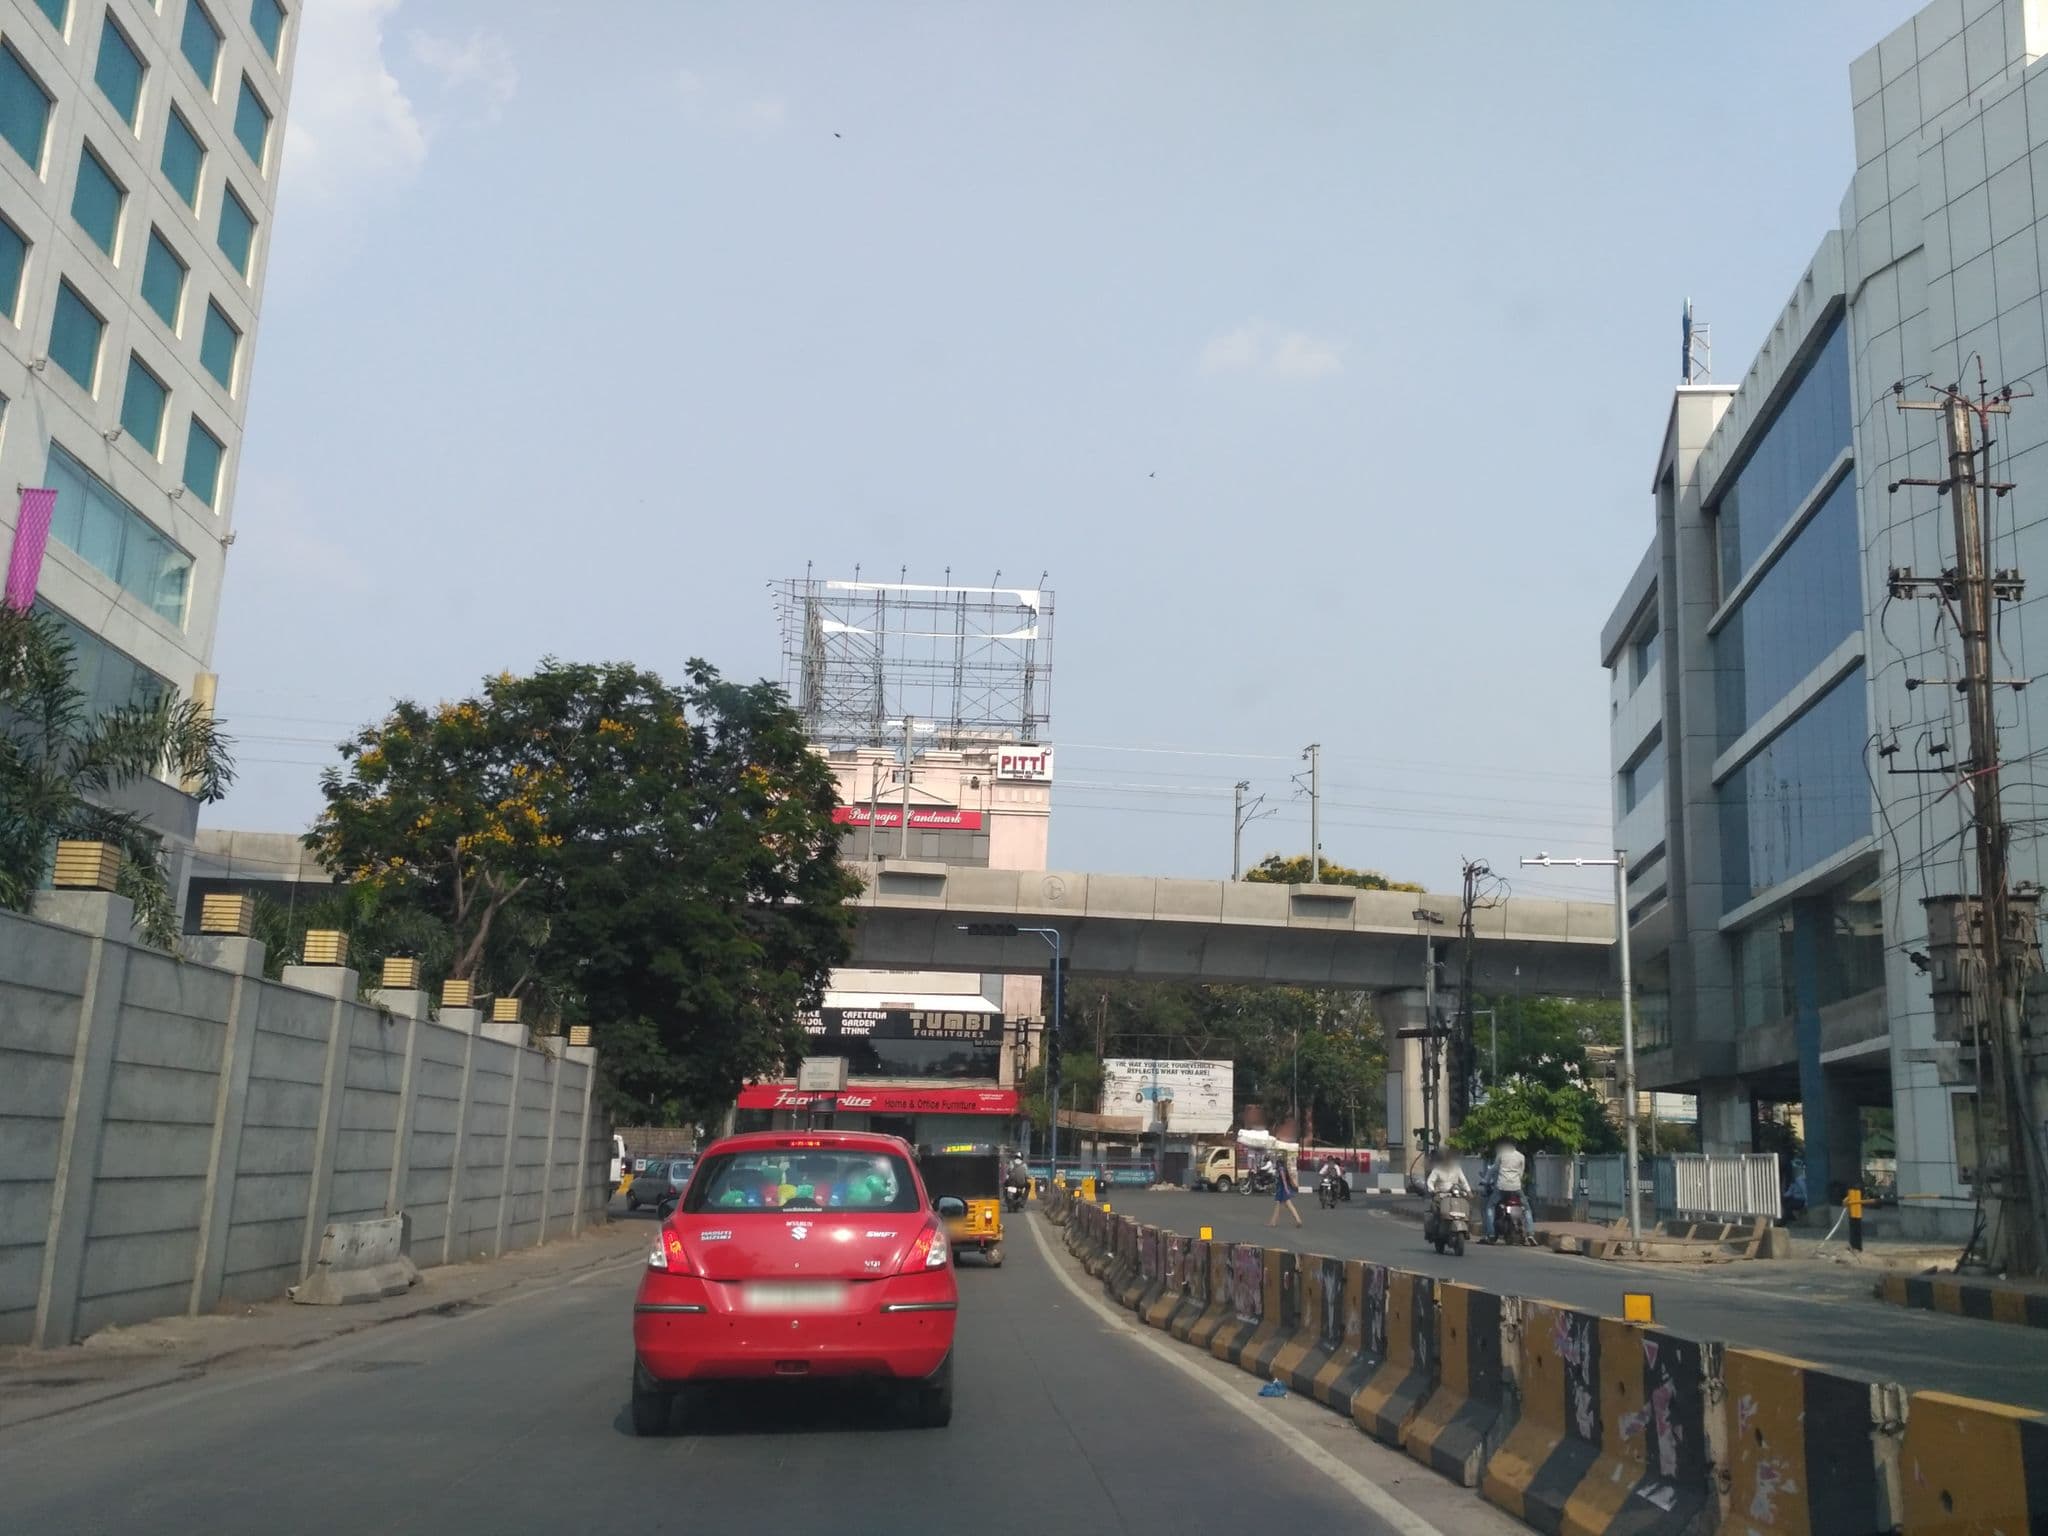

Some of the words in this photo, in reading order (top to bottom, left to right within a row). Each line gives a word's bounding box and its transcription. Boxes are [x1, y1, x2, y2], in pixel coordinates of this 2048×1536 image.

[1001, 752, 1046, 770] PITTI
[842, 1011, 887, 1020] CAFETERIA
[841, 1019, 876, 1028] GARDEN
[909, 1012, 991, 1031] TUMBI
[841, 1027, 871, 1035] ETHNIC
[913, 1029, 985, 1039] FURNITURES
[885, 1100, 907, 1109] Home
[917, 1100, 940, 1110] Office
[942, 1100, 977, 1110] Furniture
